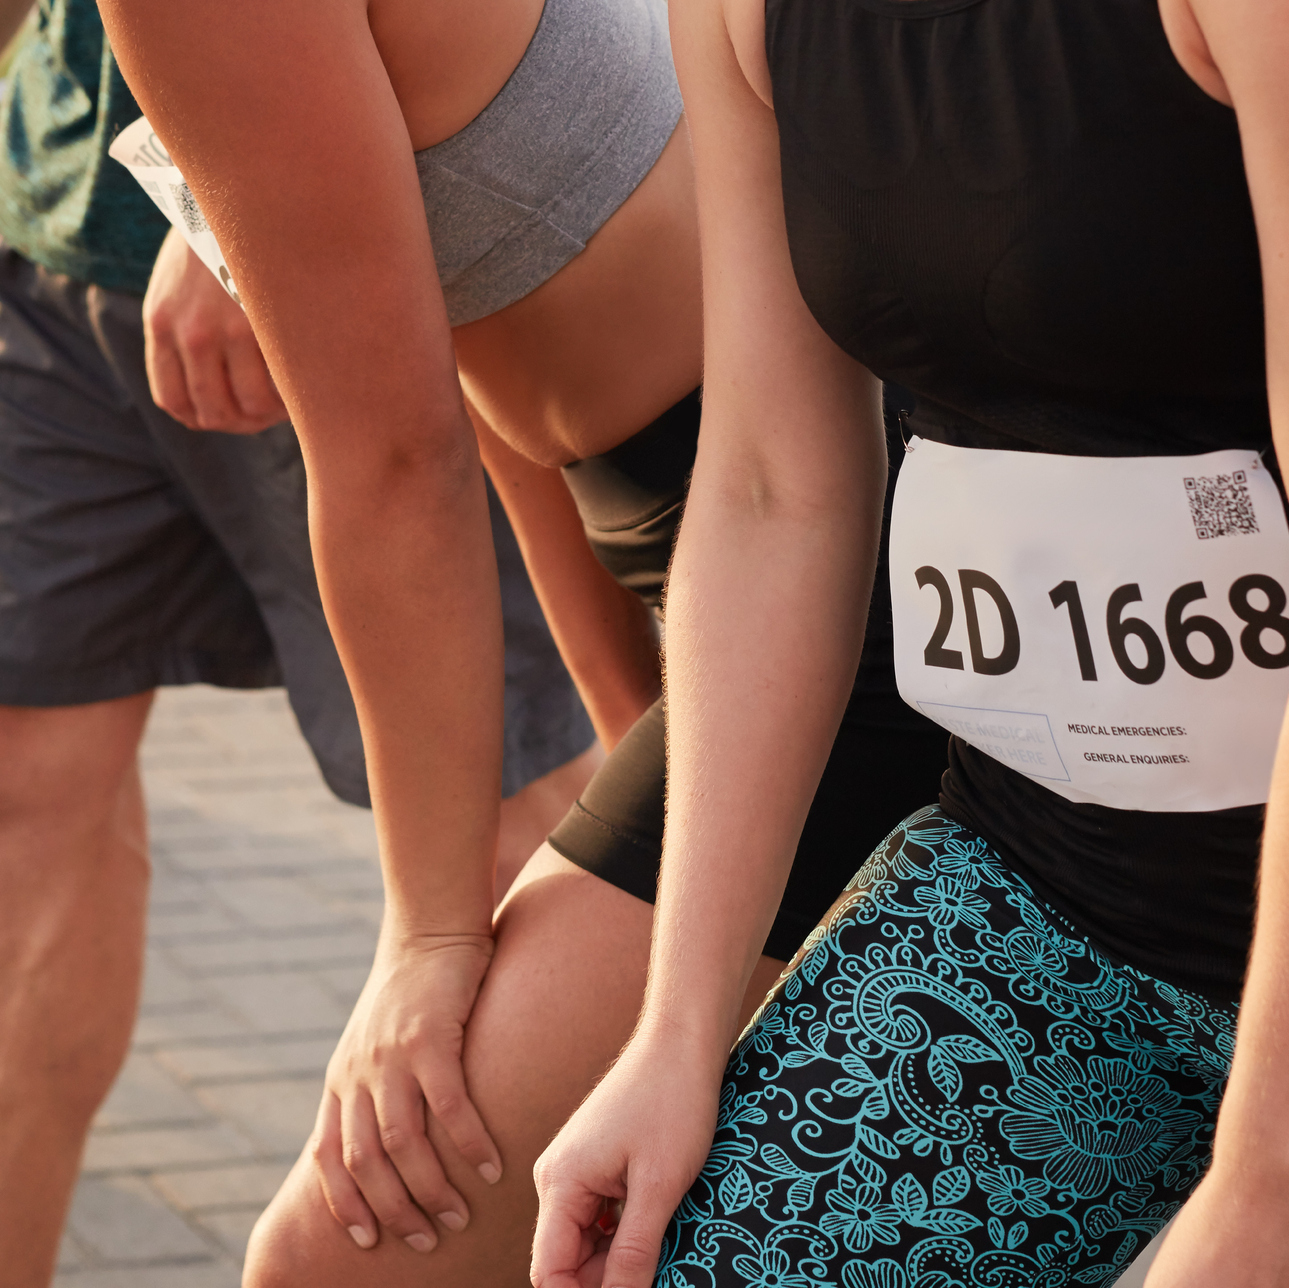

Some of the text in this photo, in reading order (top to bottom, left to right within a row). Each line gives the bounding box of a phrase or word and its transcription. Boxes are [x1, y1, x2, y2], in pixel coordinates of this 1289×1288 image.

[914, 565, 1021, 676] 2D
[1067, 723, 1188, 737] MEDICAL EMERGENCIES:
[1005, 748, 1048, 766] HERE
[1083, 752, 1190, 765] GENERAL ENQUIRIES:
